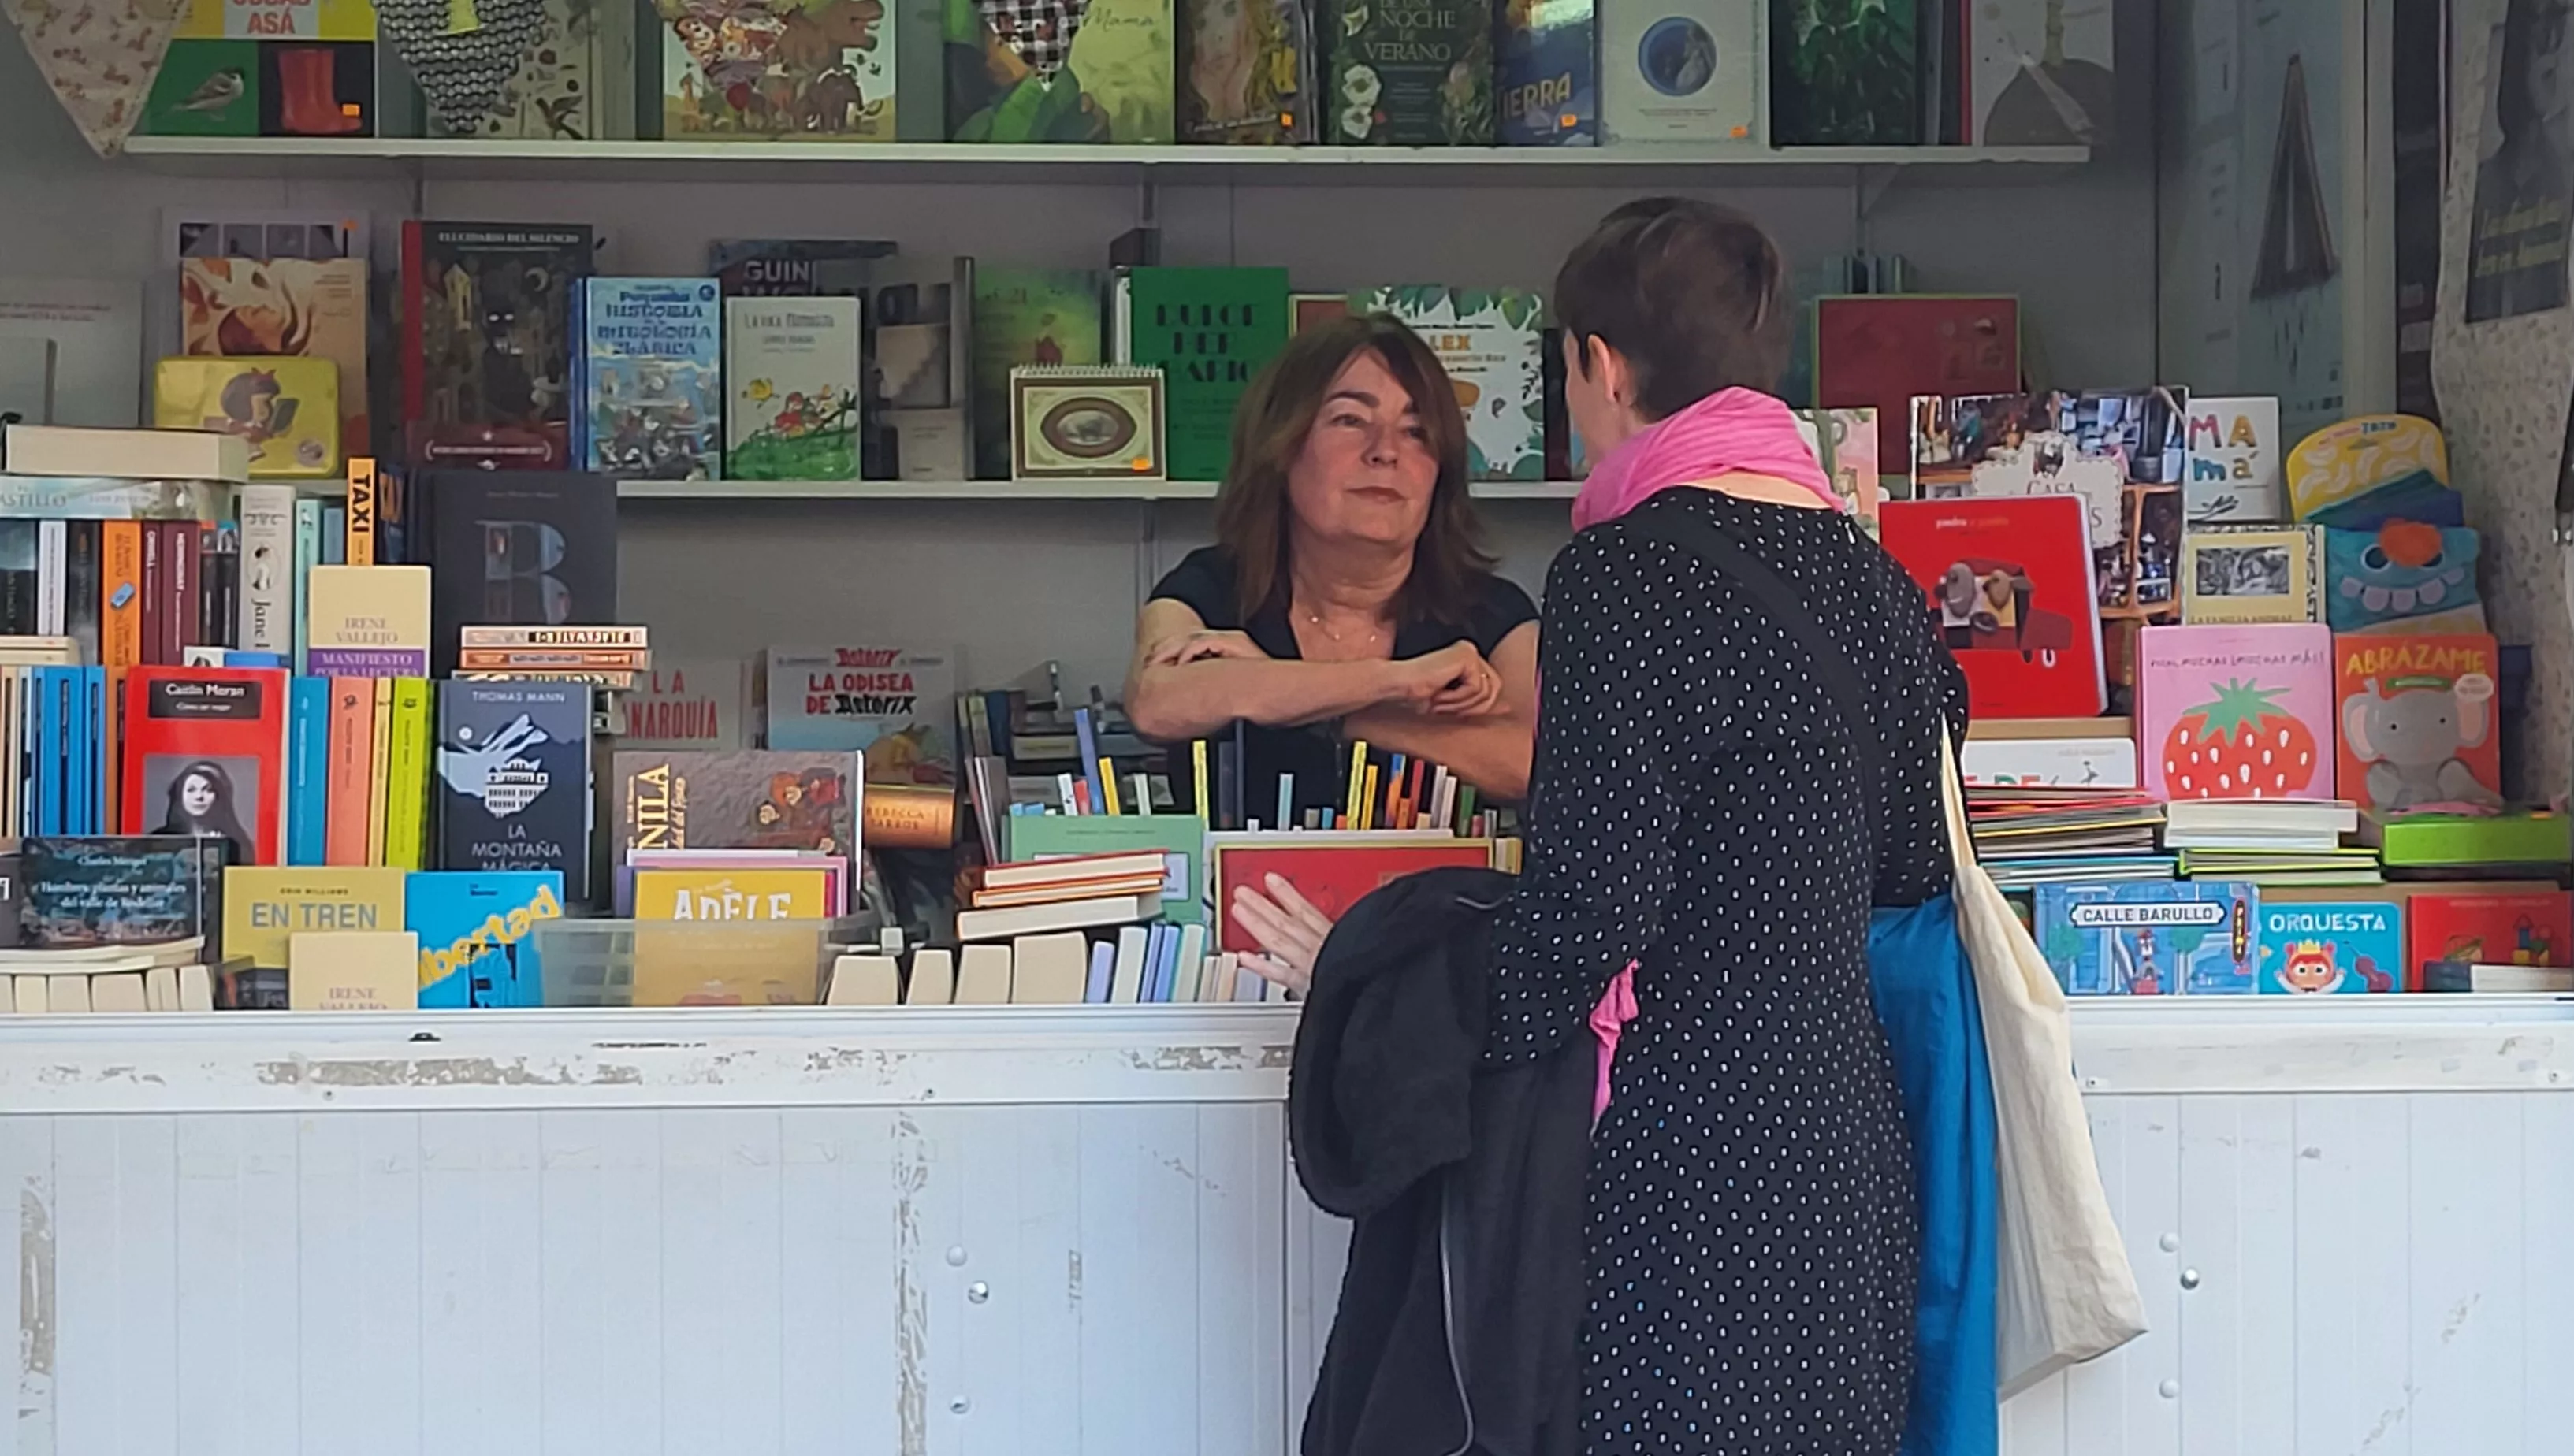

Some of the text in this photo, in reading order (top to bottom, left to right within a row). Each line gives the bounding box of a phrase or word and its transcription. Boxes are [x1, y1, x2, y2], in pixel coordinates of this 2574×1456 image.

[247, 6, 296, 34] ASÁ
[1379, 9, 1456, 28] NOCHE
[1364, 42, 1452, 61] VERANO
[1503, 71, 1571, 120] IERRA
[1430, 335, 1471, 351] LEX
[2188, 414, 2257, 451] MA
[352, 474, 370, 533] TAXI
[251, 597, 272, 638] Jane
[345, 618, 386, 629] IRENE
[335, 632, 399, 645] VALLEJO
[321, 653, 414, 665] MANIFIESTO
[2345, 642, 2487, 678] ABRÁZAME
[652, 670, 685, 693] LA
[809, 673, 914, 692] LA ODISEA
[472, 691, 566, 703] THOMAS MANN
[806, 695, 831, 715] DE
[508, 824, 526, 838] LA
[471, 840, 563, 857] MONTAÑA
[251, 902, 377, 928] EN TREN
[2083, 906, 2213, 923] CALLE BARULLO
[2269, 912, 2386, 933] ORQUESTA
[419, 884, 560, 990] ibertad
[329, 987, 377, 999] IRENE
